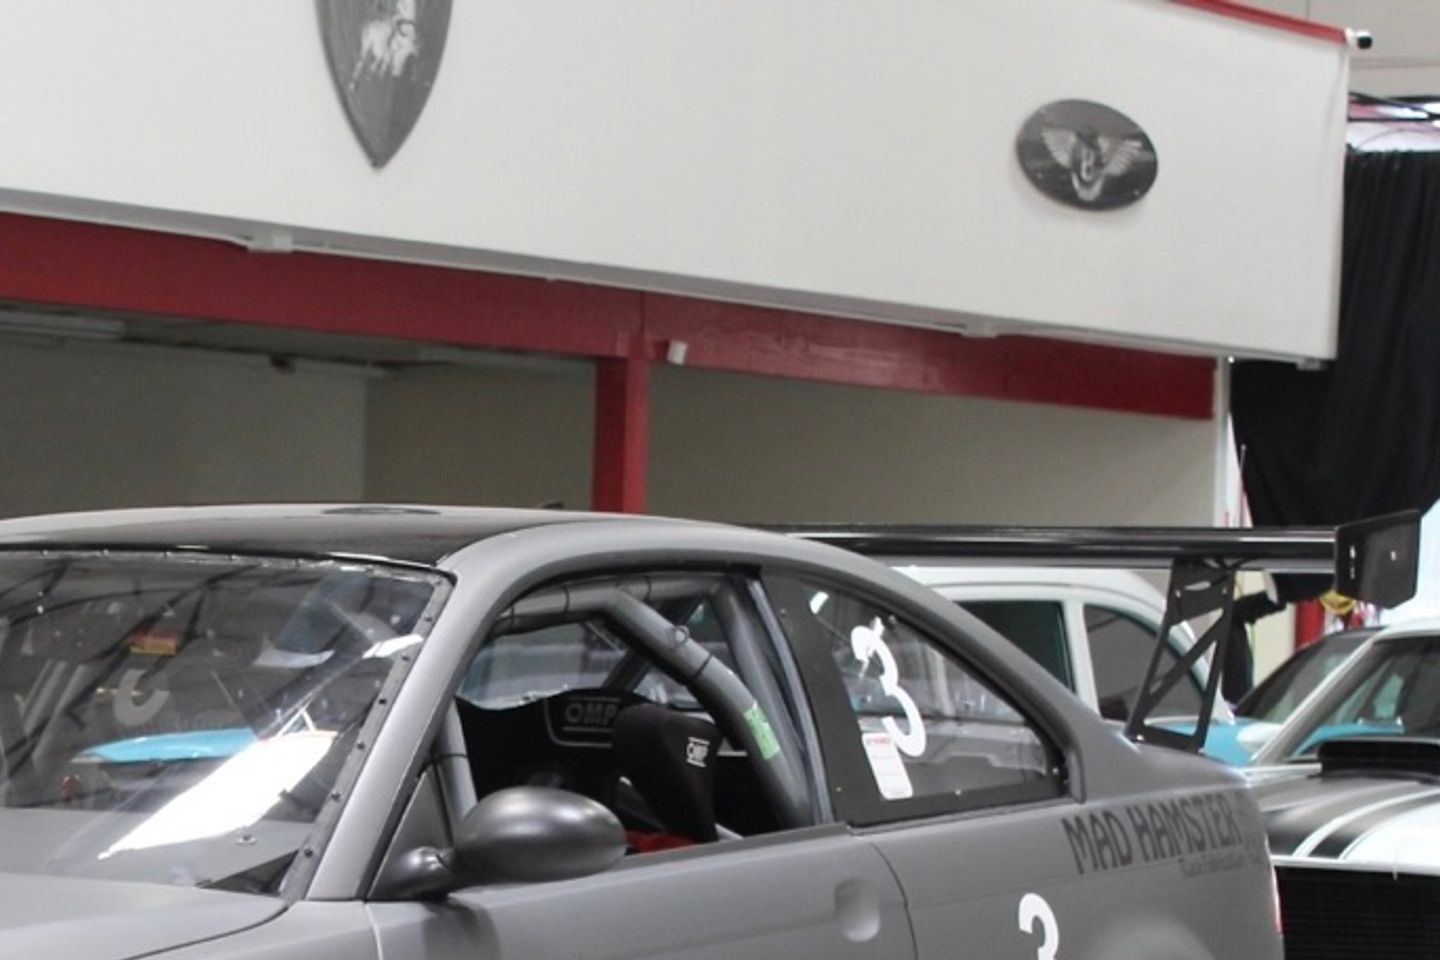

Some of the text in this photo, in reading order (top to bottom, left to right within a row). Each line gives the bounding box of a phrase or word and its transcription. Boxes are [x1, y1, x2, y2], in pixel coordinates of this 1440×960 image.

[565, 702, 617, 725] OMP
[1061, 810, 1133, 875] MAD
[1126, 792, 1243, 862] HAMSTER
